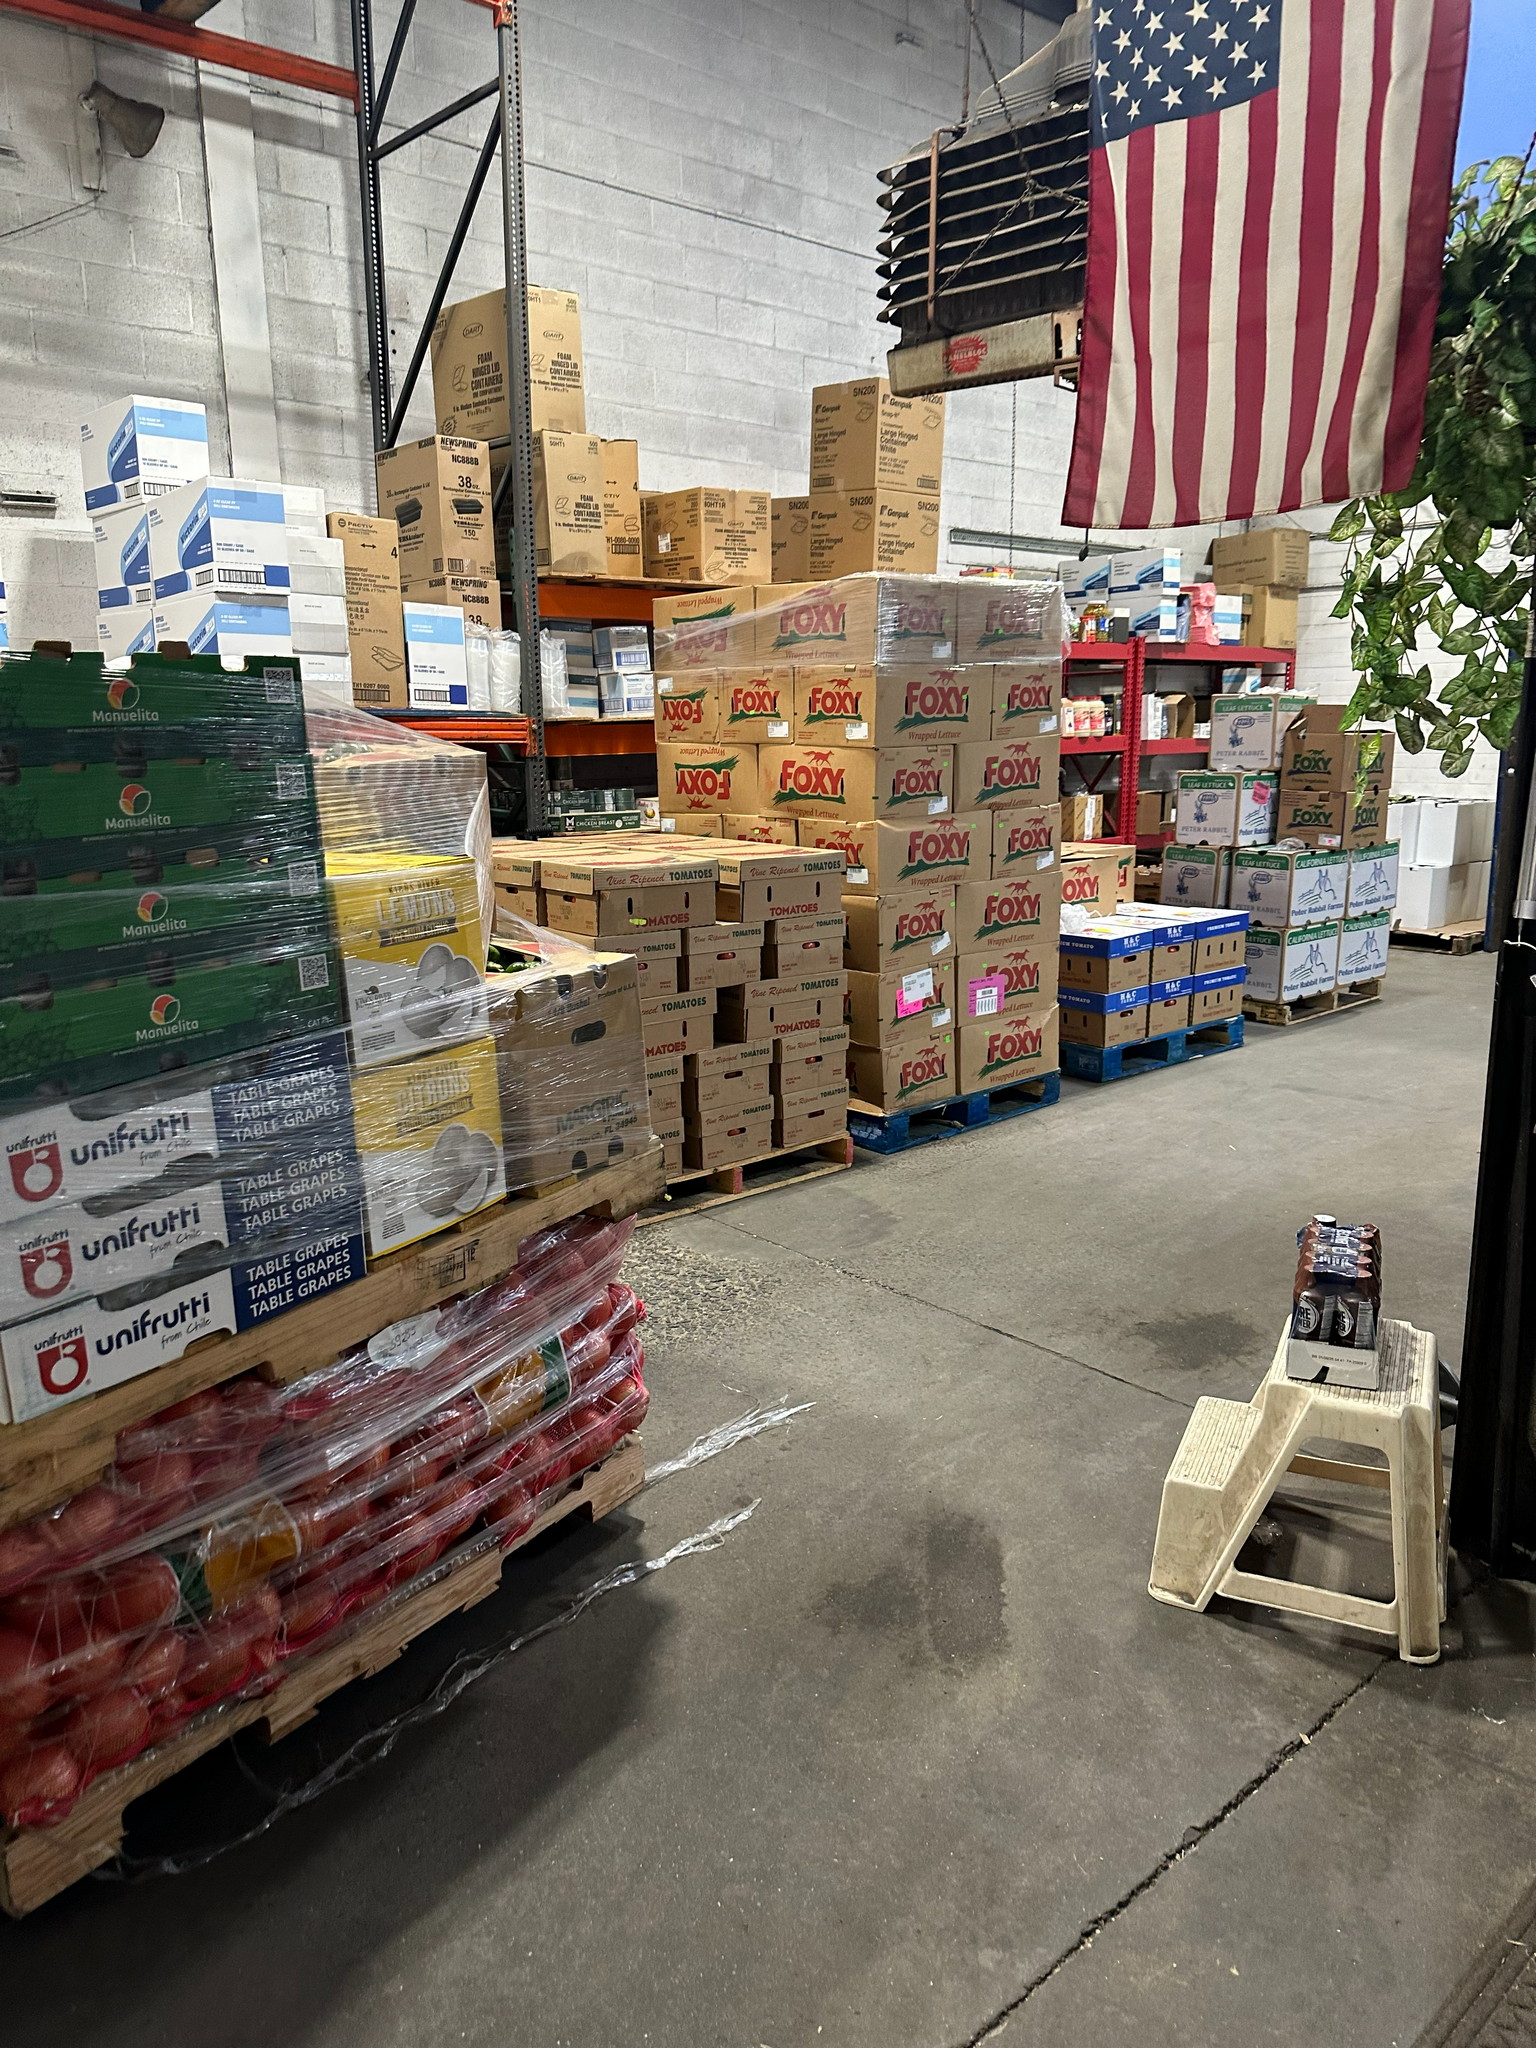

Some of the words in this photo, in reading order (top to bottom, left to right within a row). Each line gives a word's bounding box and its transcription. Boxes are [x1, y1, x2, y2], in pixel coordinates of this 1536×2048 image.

[477, 351, 493, 365] FOAM
[551, 359, 569, 369] HINGED
[557, 352, 572, 361] FOAM
[472, 364, 491, 379] HINGED
[491, 361, 500, 374] LID
[549, 368, 581, 379] CONTAINERS
[471, 373, 503, 391] CONTAINERS
[853, 385, 876, 397] SN200
[821, 404, 841, 413] Genpak
[890, 397, 913, 410] Genpak
[814, 431, 828, 440] Large
[829, 428, 847, 438] Hinged
[880, 427, 897, 439] Large
[898, 430, 918, 441] Hinged
[440, 437, 477, 450] NEWSPRING
[814, 438, 838, 446] Container
[879, 436, 908, 448] Container
[880, 444, 897, 454] White
[451, 454, 479, 466] NC888B
[458, 475, 472, 489] 38
[633, 481, 638, 492] 4
[580, 494, 594, 502] FOAM
[850, 496, 873, 507] SN200
[575, 502, 591, 510] HINGED
[887, 508, 909, 519] Genpak
[918, 501, 939, 512] SN200
[574, 510, 601, 518] CONTAINERS
[818, 511, 838, 520] Genpak
[464, 529, 476, 537] 150
[810, 538, 825, 546] Large
[826, 536, 843, 545] Hinged
[810, 544, 834, 552] Container
[878, 538, 895, 548] Large
[896, 540, 915, 551] Hinged
[391, 547, 398, 559] 4
[878, 546, 905, 557] Container
[878, 554, 894, 563] White
[451, 578, 489, 589] NEWSPRING
[462, 594, 489, 605] NC888B
[779, 602, 847, 635] FOXY
[897, 602, 947, 633] FOXY
[733, 688, 780, 713] FOXY
[811, 688, 863, 714] FOXY
[906, 681, 970, 716] FOXY
[1009, 684, 1053, 710] FOXY
[93, 708, 160, 723] Manuelita
[662, 698, 703, 724] FOXY
[1237, 704, 1264, 712] LETTUCE
[908, 730, 937, 741] Wrapped
[938, 730, 961, 740] Lettuce
[1293, 753, 1333, 770] FOXY
[781, 759, 845, 796] FOXY
[985, 756, 1041, 788] FOXY
[676, 768, 731, 800] FOXY
[895, 768, 943, 795] FOXY
[787, 806, 814, 817] Wrapped
[814, 809, 839, 819] Lettuce
[1292, 808, 1333, 824] FOXY
[1355, 806, 1380, 825] FOXY
[105, 813, 171, 830] Manuelita
[910, 830, 970, 864] FOXY
[1010, 826, 1054, 853] FOXY
[750, 867, 768, 877] Vine
[769, 865, 800, 876] Ripened
[803, 860, 841, 872] TOMATOES
[1242, 859, 1255, 867] LEAF
[1256, 861, 1281, 869] LETTUCE
[1295, 856, 1327, 869] CALIFORNIA
[606, 875, 627, 886] Vine
[629, 874, 666, 885] Ripened
[669, 869, 713, 881] TOMATOES
[911, 876, 940, 886] Wrapped
[941, 873, 962, 884] Lettuce
[1062, 875, 1100, 902] OXY
[376, 888, 457, 925] LEMONS
[769, 903, 819, 917] TOMATOES
[985, 894, 1041, 925] FOXY
[1308, 905, 1327, 914] Rabbit
[122, 917, 187, 938] Manuelita
[816, 918, 844, 928] TOMATOES
[899, 910, 945, 940] FOXY
[1344, 920, 1371, 932] CALIFORNIA
[732, 927, 762, 937] TOMATOES
[987, 936, 1013, 946] Wrapped
[1014, 933, 1035, 943] Lettuce
[1288, 932, 1317, 945] CALIFORNIA
[1317, 928, 1339, 940] LETTUCE
[643, 942, 676, 953] TOMATOES
[1355, 965, 1372, 974] Rabbit
[750, 988, 768, 997] Vine
[769, 984, 799, 995] Ripened
[801, 977, 839, 992] TOMATOES
[1300, 979, 1318, 989] Rabbit
[661, 996, 707, 1013] TOMATOES
[1014, 1001, 1034, 1011] Lettuce
[1068, 995, 1091, 1003] TOMATO
[135, 1019, 199, 1042] Manuelita
[774, 1018, 821, 1034] TOMATOES
[819, 1032, 847, 1044] TOMATOES
[988, 1028, 1042, 1063] FOXY
[645, 1041, 687, 1058] MATOES
[740, 1047, 770, 1059] TOMATOES
[902, 1054, 946, 1088] FOXY
[990, 1071, 1016, 1083] Wrapped
[1016, 1066, 1036, 1077] Lettuce
[229, 1080, 278, 1106] TABLE
[279, 1065, 335, 1092] GRAPES
[820, 1086, 847, 1098] TOMATOES
[231, 1099, 280, 1125] TABLE
[281, 1082, 337, 1109] GRAPES
[742, 1103, 771, 1115] TOMATOES
[234, 1116, 281, 1143] TABLE
[282, 1100, 340, 1127] GRAPES
[6, 1130, 57, 1153] unifrutti
[71, 1112, 191, 1166] unifrutti
[139, 1148, 163, 1167] from
[166, 1139, 193, 1154] Chile
[238, 1169, 283, 1195] TABLE
[287, 1149, 343, 1178] GRAPES
[240, 1187, 285, 1213] TABLE
[289, 1166, 345, 1194] GRAPES
[242, 1204, 287, 1231] TABLE
[291, 1183, 348, 1212] GRAPES
[82, 1202, 201, 1262] unifrutti
[18, 1229, 69, 1252] unifrutti
[150, 1240, 171, 1258] from
[175, 1229, 202, 1245] Chile
[246, 1257, 291, 1282] TABLE
[294, 1232, 349, 1262] GRAPES
[248, 1273, 293, 1300] TABLE
[296, 1248, 350, 1280] GRAPES
[250, 1290, 294, 1318] TABLE
[297, 1265, 352, 1298] GRAPES
[95, 1292, 211, 1356] unifrutti
[34, 1325, 83, 1351] unifrutti
[161, 1332, 183, 1350] from
[186, 1317, 212, 1334] Chile
